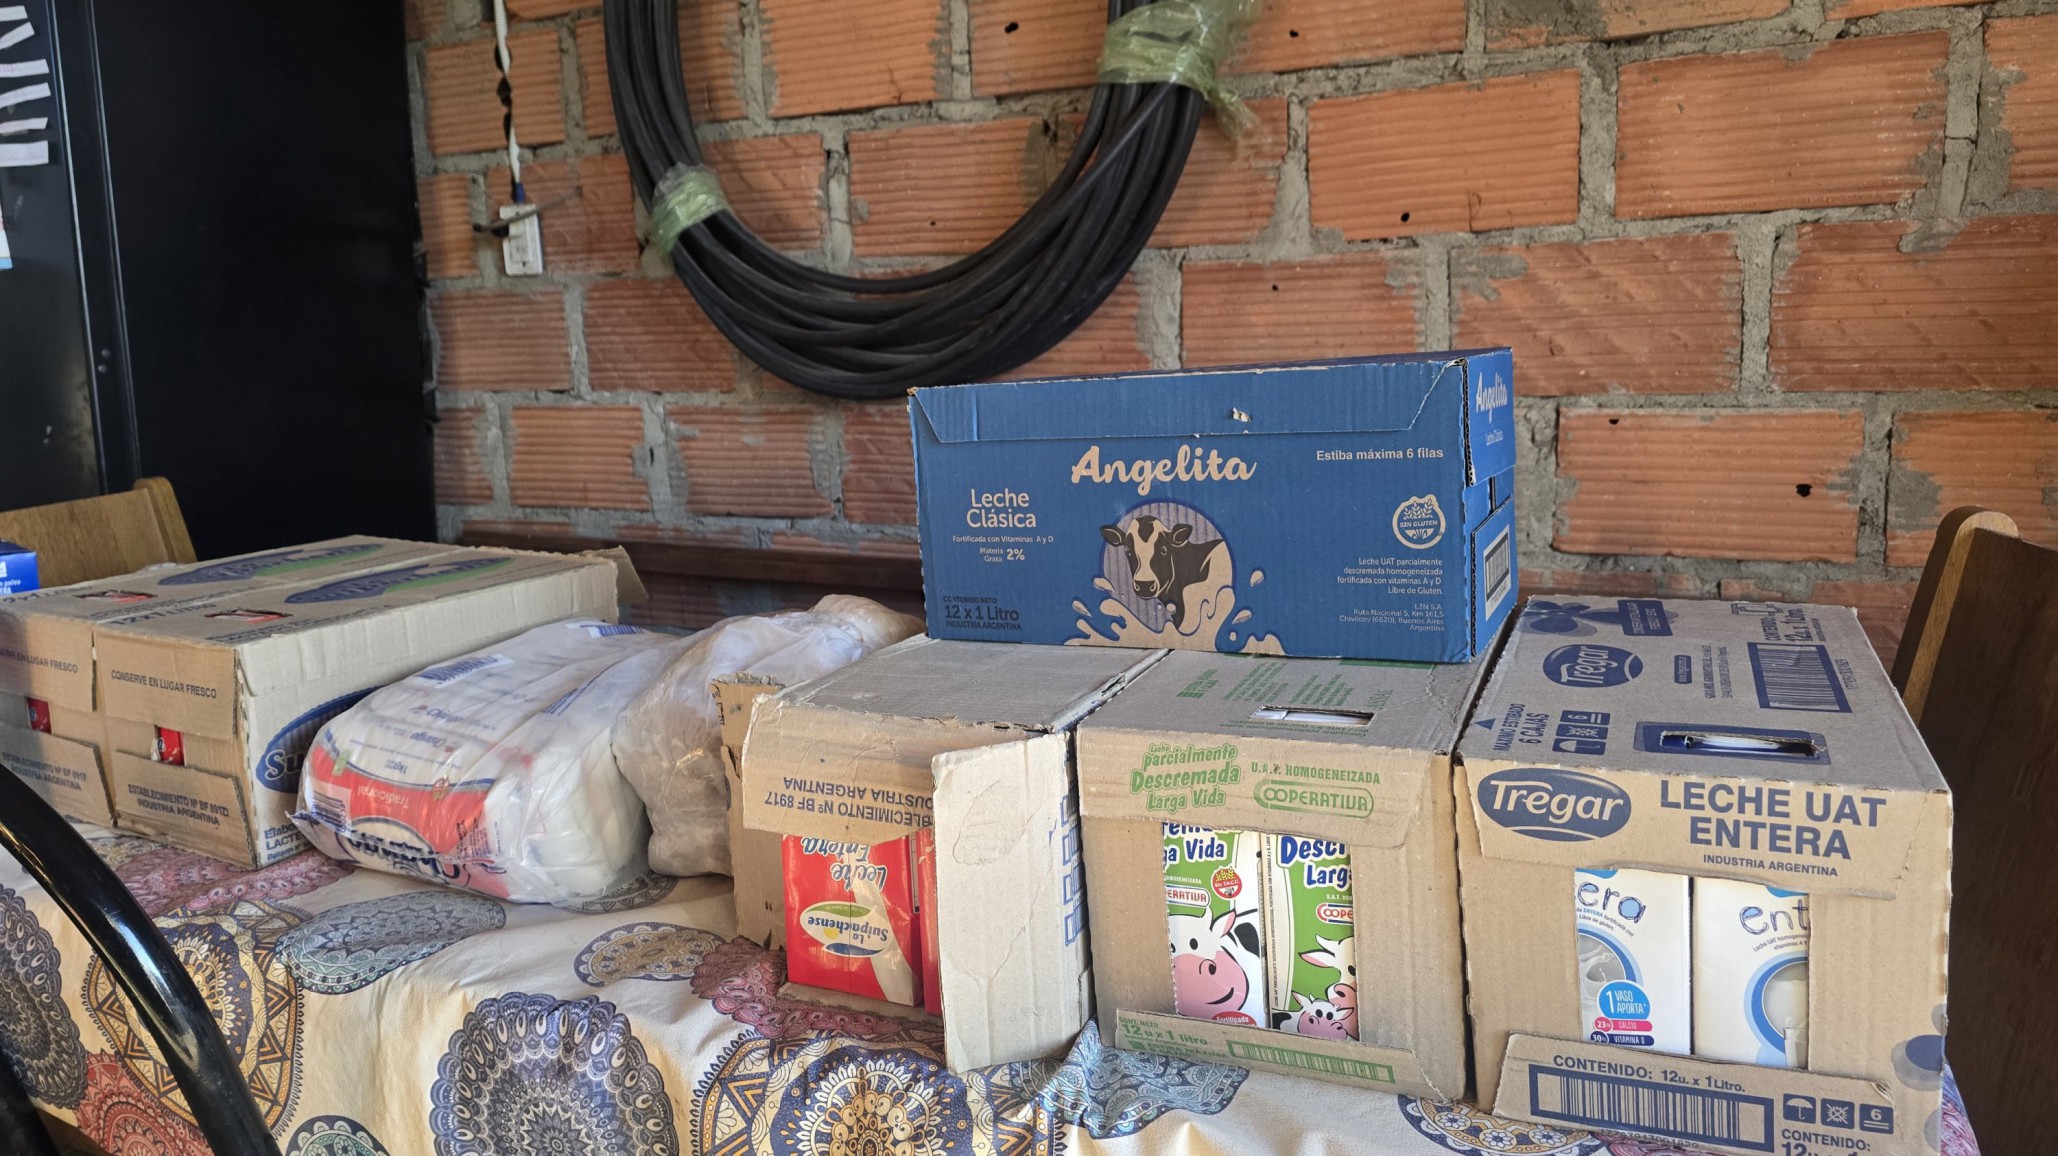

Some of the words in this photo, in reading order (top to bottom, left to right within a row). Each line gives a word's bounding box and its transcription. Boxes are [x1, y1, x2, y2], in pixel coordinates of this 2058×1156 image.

[1476, 371, 1508, 424] Angelita
[1316, 450, 1353, 461] Estiba
[1356, 448, 1403, 460] máxima
[1406, 448, 1414, 458] 6
[1417, 447, 1444, 458] filas
[1071, 444, 1257, 496] Angelita
[970, 487, 1030, 508] Leche
[966, 508, 1037, 528] Clásica
[952, 535, 987, 543] Fortificada
[1001, 535, 1034, 543] Vitaminas
[1048, 535, 1054, 543] D
[984, 555, 1003, 563] Grasa
[1006, 548, 1026, 561] 2%
[1358, 557, 1379, 565] Leche
[1380, 557, 1396, 565] UAT
[1396, 558, 1443, 567] parcialmente
[1337, 576, 1373, 584] fortificada
[1388, 577, 1421, 585] vitaminas
[1422, 577, 1428, 585] A
[1343, 567, 1385, 575] descremada
[1386, 568, 1443, 577] homogeneizada
[1387, 586, 1406, 594] Libre
[1406, 586, 1416, 594] de
[944, 604, 961, 619] 12
[964, 608, 973, 619] x
[975, 605, 984, 620] 1
[987, 606, 1020, 621] Litro
[982, 621, 1022, 631] ARGENTINA
[49, 659, 78, 674] FRESCO
[1560, 645, 1618, 684] Tregar
[111, 669, 148, 686] CONSERVE
[148, 677, 159, 688] EN
[160, 679, 185, 693] LUGAR
[186, 683, 217, 699] FRESCO
[1502, 703, 1526, 728] ESTIBADO
[1520, 712, 1550, 737] CAJAS
[1493, 728, 1516, 752] MAXIMO
[1144, 744, 1238, 772] parcialmente
[1131, 760, 1240, 793] Descremada
[1285, 764, 1381, 785] HOMOGENEIZADA
[128, 784, 190, 807] ESTABLECIMIENTO
[357, 784, 410, 809] Tradicional
[764, 791, 795, 809] 8917
[783, 777, 867, 800] ARGENTINA
[1147, 793, 1187, 812] Larga
[1192, 787, 1225, 806] Vida
[137, 798, 176, 815] INDUSTRIA
[177, 806, 220, 826] ARGENTINA
[797, 798, 815, 812] BF
[1490, 780, 1624, 824] Tregar
[1660, 780, 1791, 818] LECHE
[1805, 791, 1887, 827] UAT
[838, 801, 934, 828] BLECIMIENTO
[1186, 836, 1225, 860] Vida
[1689, 816, 1852, 860] ENTERA
[1703, 854, 1765, 869] INDUSTRIA
[1768, 860, 1838, 877] ARGENTINA
[831, 864, 887, 891] Leche
[808, 915, 889, 941] Suipachense
[1583, 907, 1604, 918] ENTERA
[1604, 914, 1627, 932] fortificada
[853, 932, 865, 944] La
[1606, 990, 1615, 1014] 1
[1614, 990, 1633, 1002] VASO
[1122, 1023, 1142, 1036] 12
[1156, 1031, 1163, 1039] x
[1165, 1029, 1175, 1041] 1
[1179, 1033, 1208, 1045] litro
[1618, 1021, 1637, 1029] CALCIO
[1614, 1035, 1640, 1044] VITAMINA
[1553, 1054, 1653, 1080] CONTENIDO:
[1661, 1069, 1689, 1085] 12u.
[1692, 1076, 1700, 1086] x
[1870, 1108, 1882, 1121] 6
[1781, 1128, 1871, 1151] CONTENIDO:
